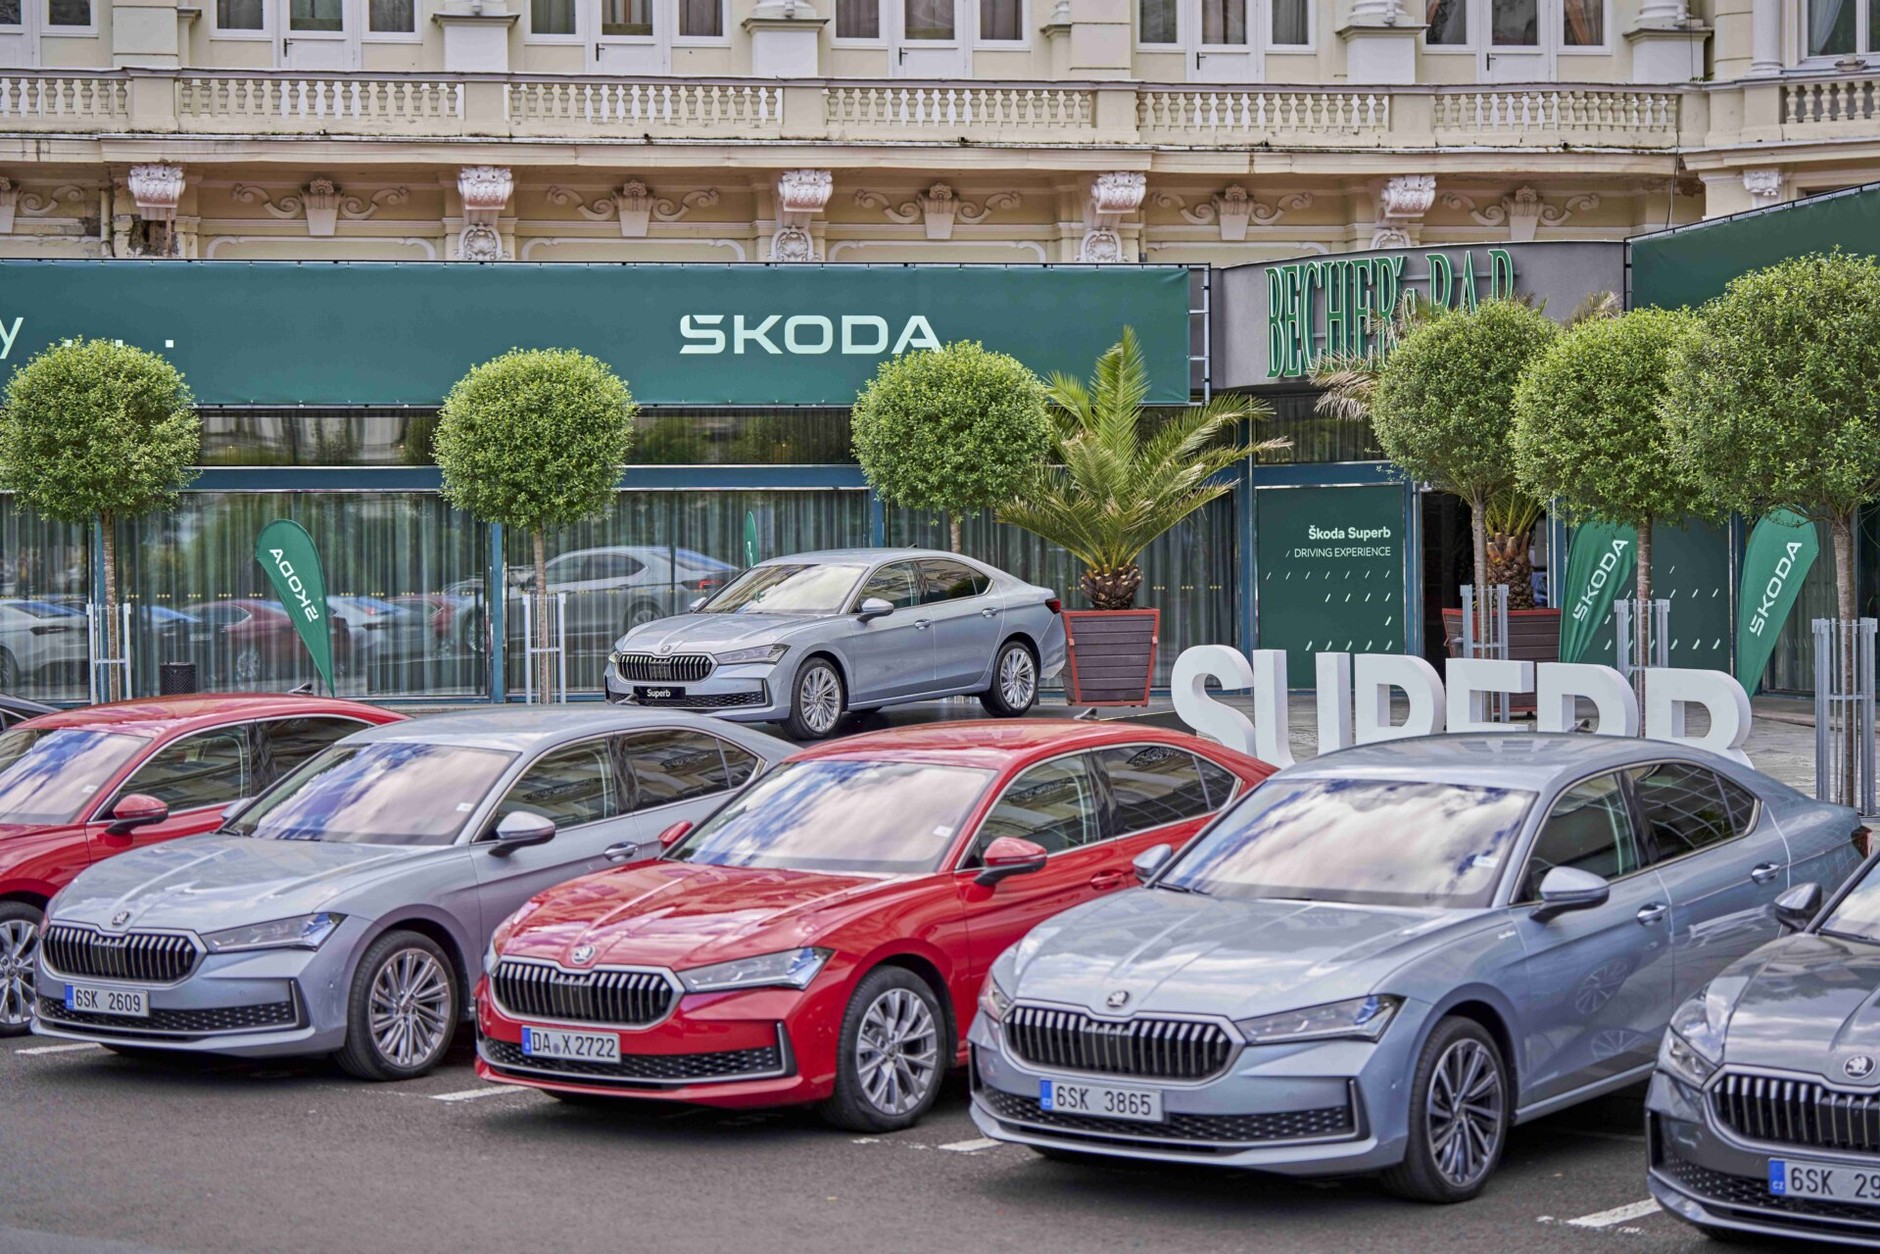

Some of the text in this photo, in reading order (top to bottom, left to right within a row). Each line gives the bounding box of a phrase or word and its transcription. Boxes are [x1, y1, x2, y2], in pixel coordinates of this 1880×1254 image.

[1308, 524, 1391, 541] Škoda Superb
[1294, 546, 1391, 558] DRIVING EXPERIENCE
[646, 688, 672, 699] Superb
[75, 988, 142, 1013] 6SK 2609
[532, 1031, 552, 1053] DA
[1056, 1085, 1152, 1116] 6SK 3865
[1790, 1166, 1880, 1200] 6SK 29
